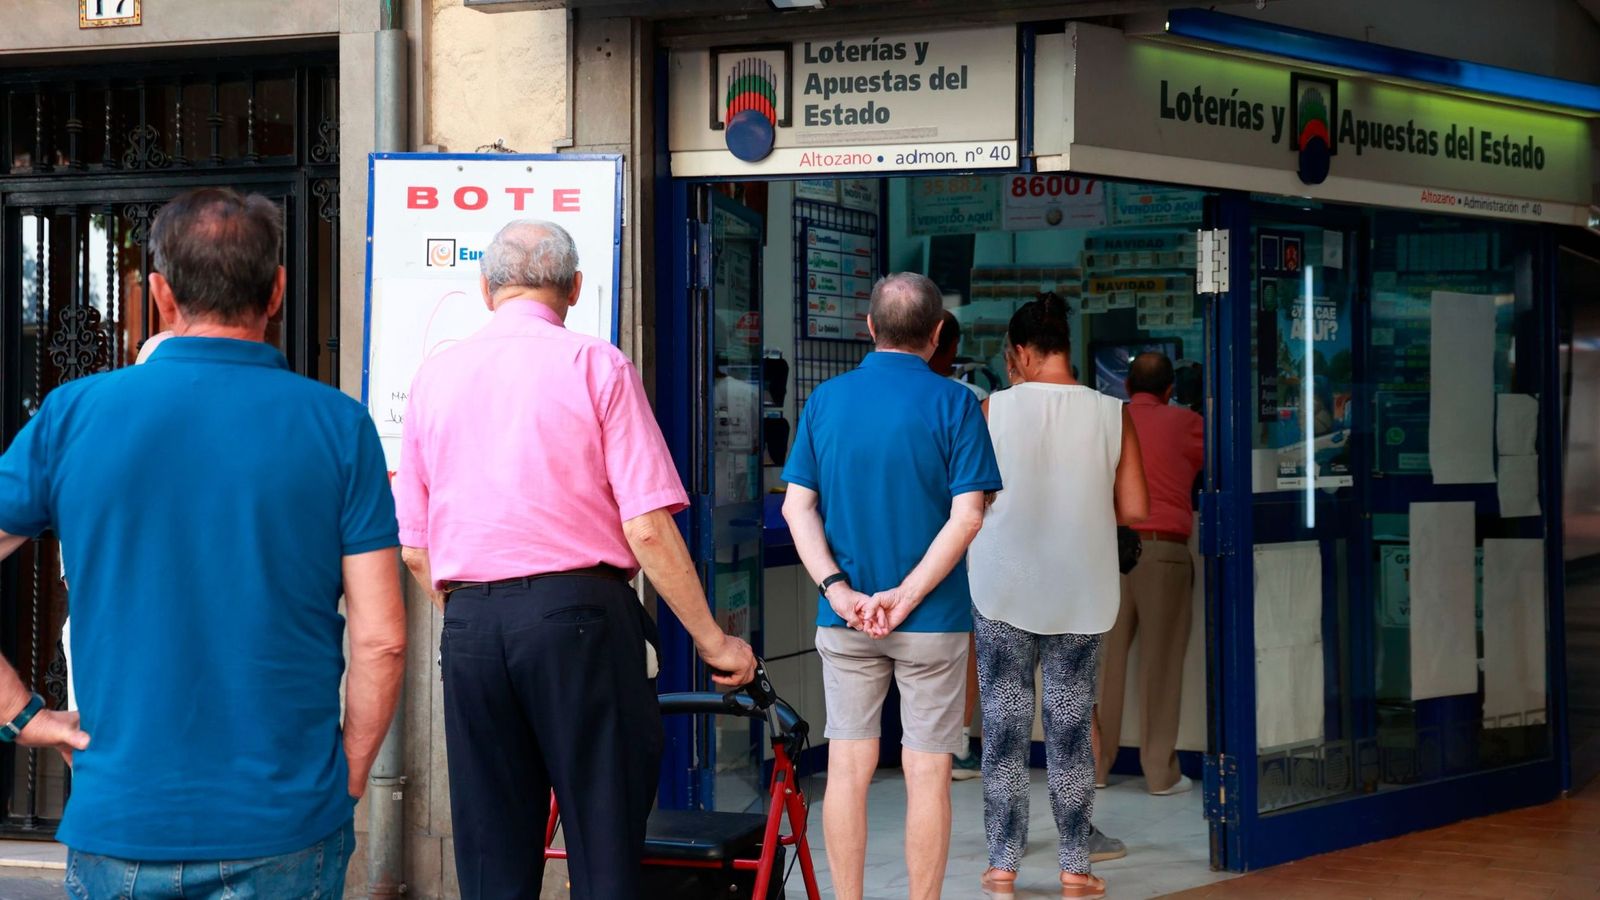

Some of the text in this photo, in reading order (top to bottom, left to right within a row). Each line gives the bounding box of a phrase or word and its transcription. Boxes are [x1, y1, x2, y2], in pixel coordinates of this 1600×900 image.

[804, 38, 929, 65] Loterías y
[804, 65, 968, 100] Apuestas del
[804, 101, 890, 127] Estado
[1160, 80, 1546, 170] Loterías y Apuestas del Estado
[799, 152, 873, 168] Altozano
[895, 149, 958, 165] admon.
[989, 145, 1011, 161] 40
[407, 186, 581, 212] BOTE
[1011, 176, 1097, 197] 86007
[1420, 190, 1456, 206] Altozano
[1464, 196, 1520, 214] Administración
[1532, 203, 1542, 216] 40
[917, 213, 965, 226] VENDIDO
[1096, 280, 1156, 291] NAVIDAD
[1290, 318, 1339, 342] AUÍ?
